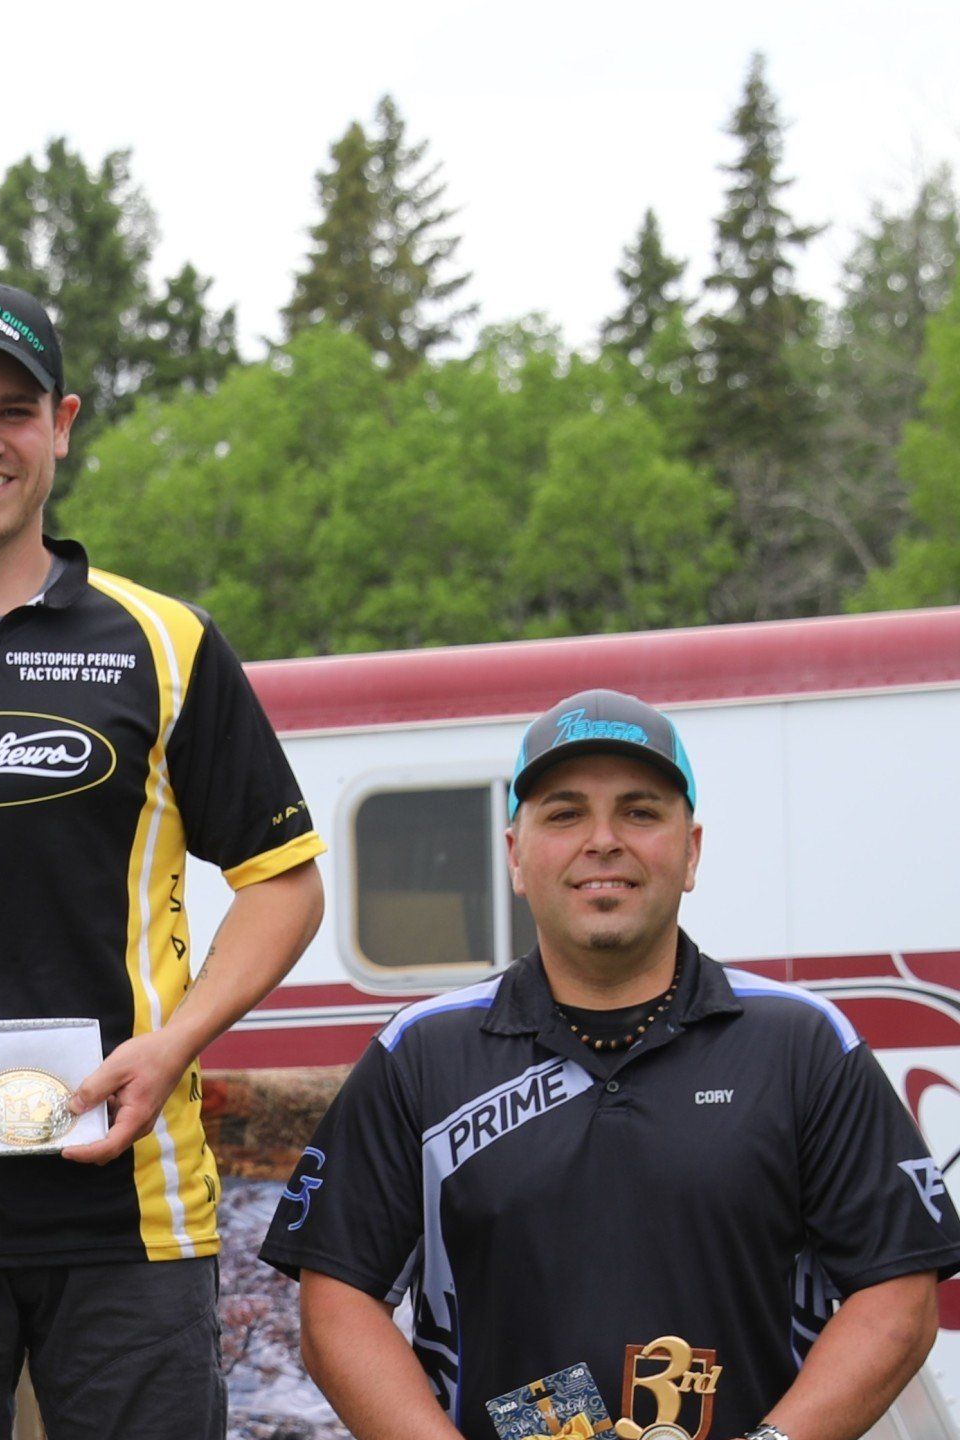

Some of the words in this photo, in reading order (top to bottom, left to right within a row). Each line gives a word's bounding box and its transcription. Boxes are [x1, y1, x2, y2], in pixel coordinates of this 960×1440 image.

[1, 310, 45, 352] Outdoor
[5, 651, 85, 666] CHRISTOPHER
[86, 652, 136, 669] PERKINS
[19, 666, 79, 682] FACTORY
[81, 667, 123, 685] STAFF
[694, 1088, 735, 1105] CORY
[447, 1065, 569, 1168] PRIME
[615, 1335, 723, 1440] 3rd
[496, 1400, 518, 1415] VISA
